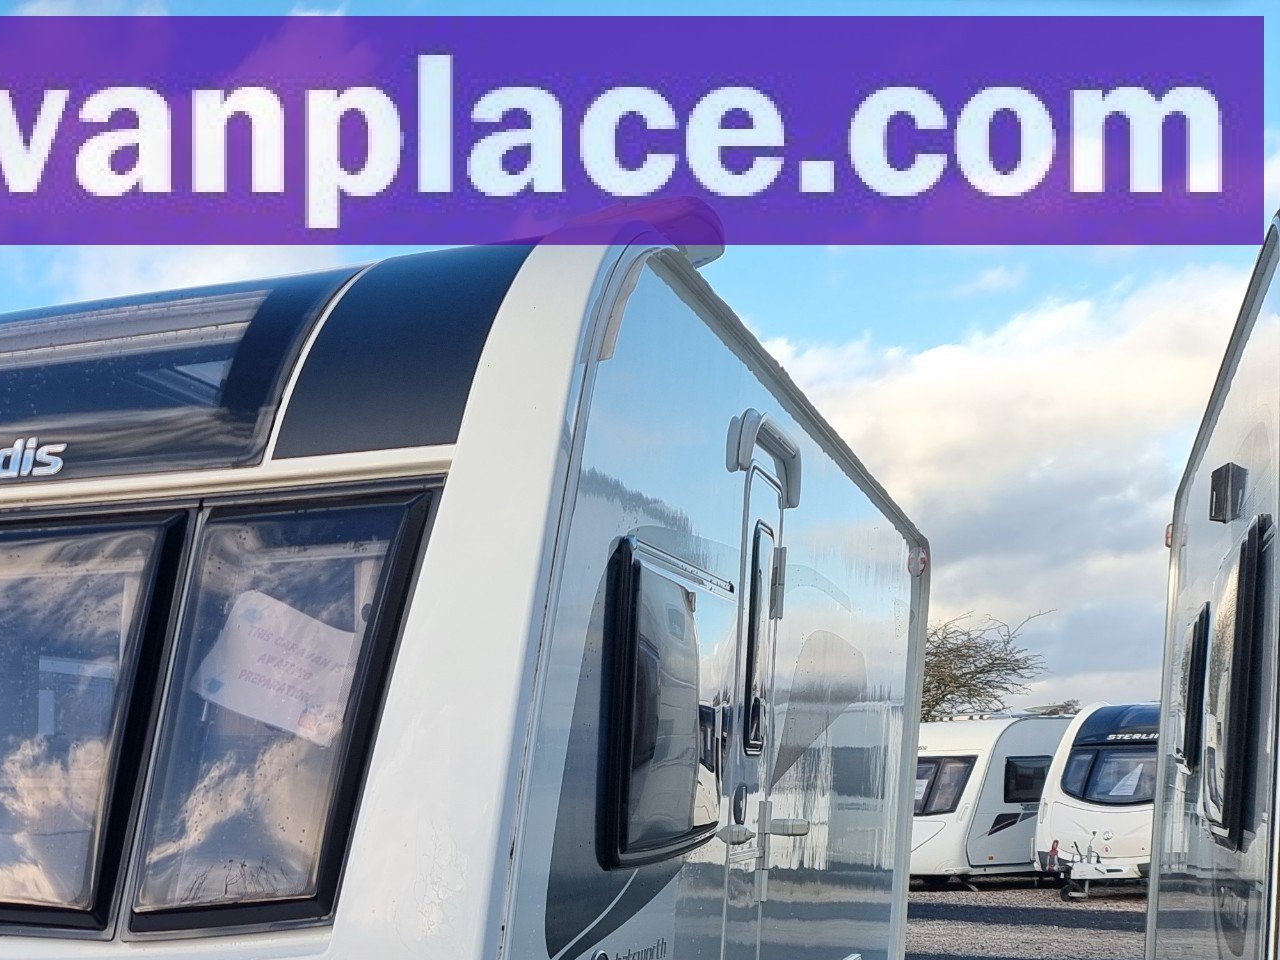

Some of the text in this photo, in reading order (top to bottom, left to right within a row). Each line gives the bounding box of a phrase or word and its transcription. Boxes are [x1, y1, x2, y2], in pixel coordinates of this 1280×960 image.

[247, 625, 345, 673] THIS CARAVAN IS
